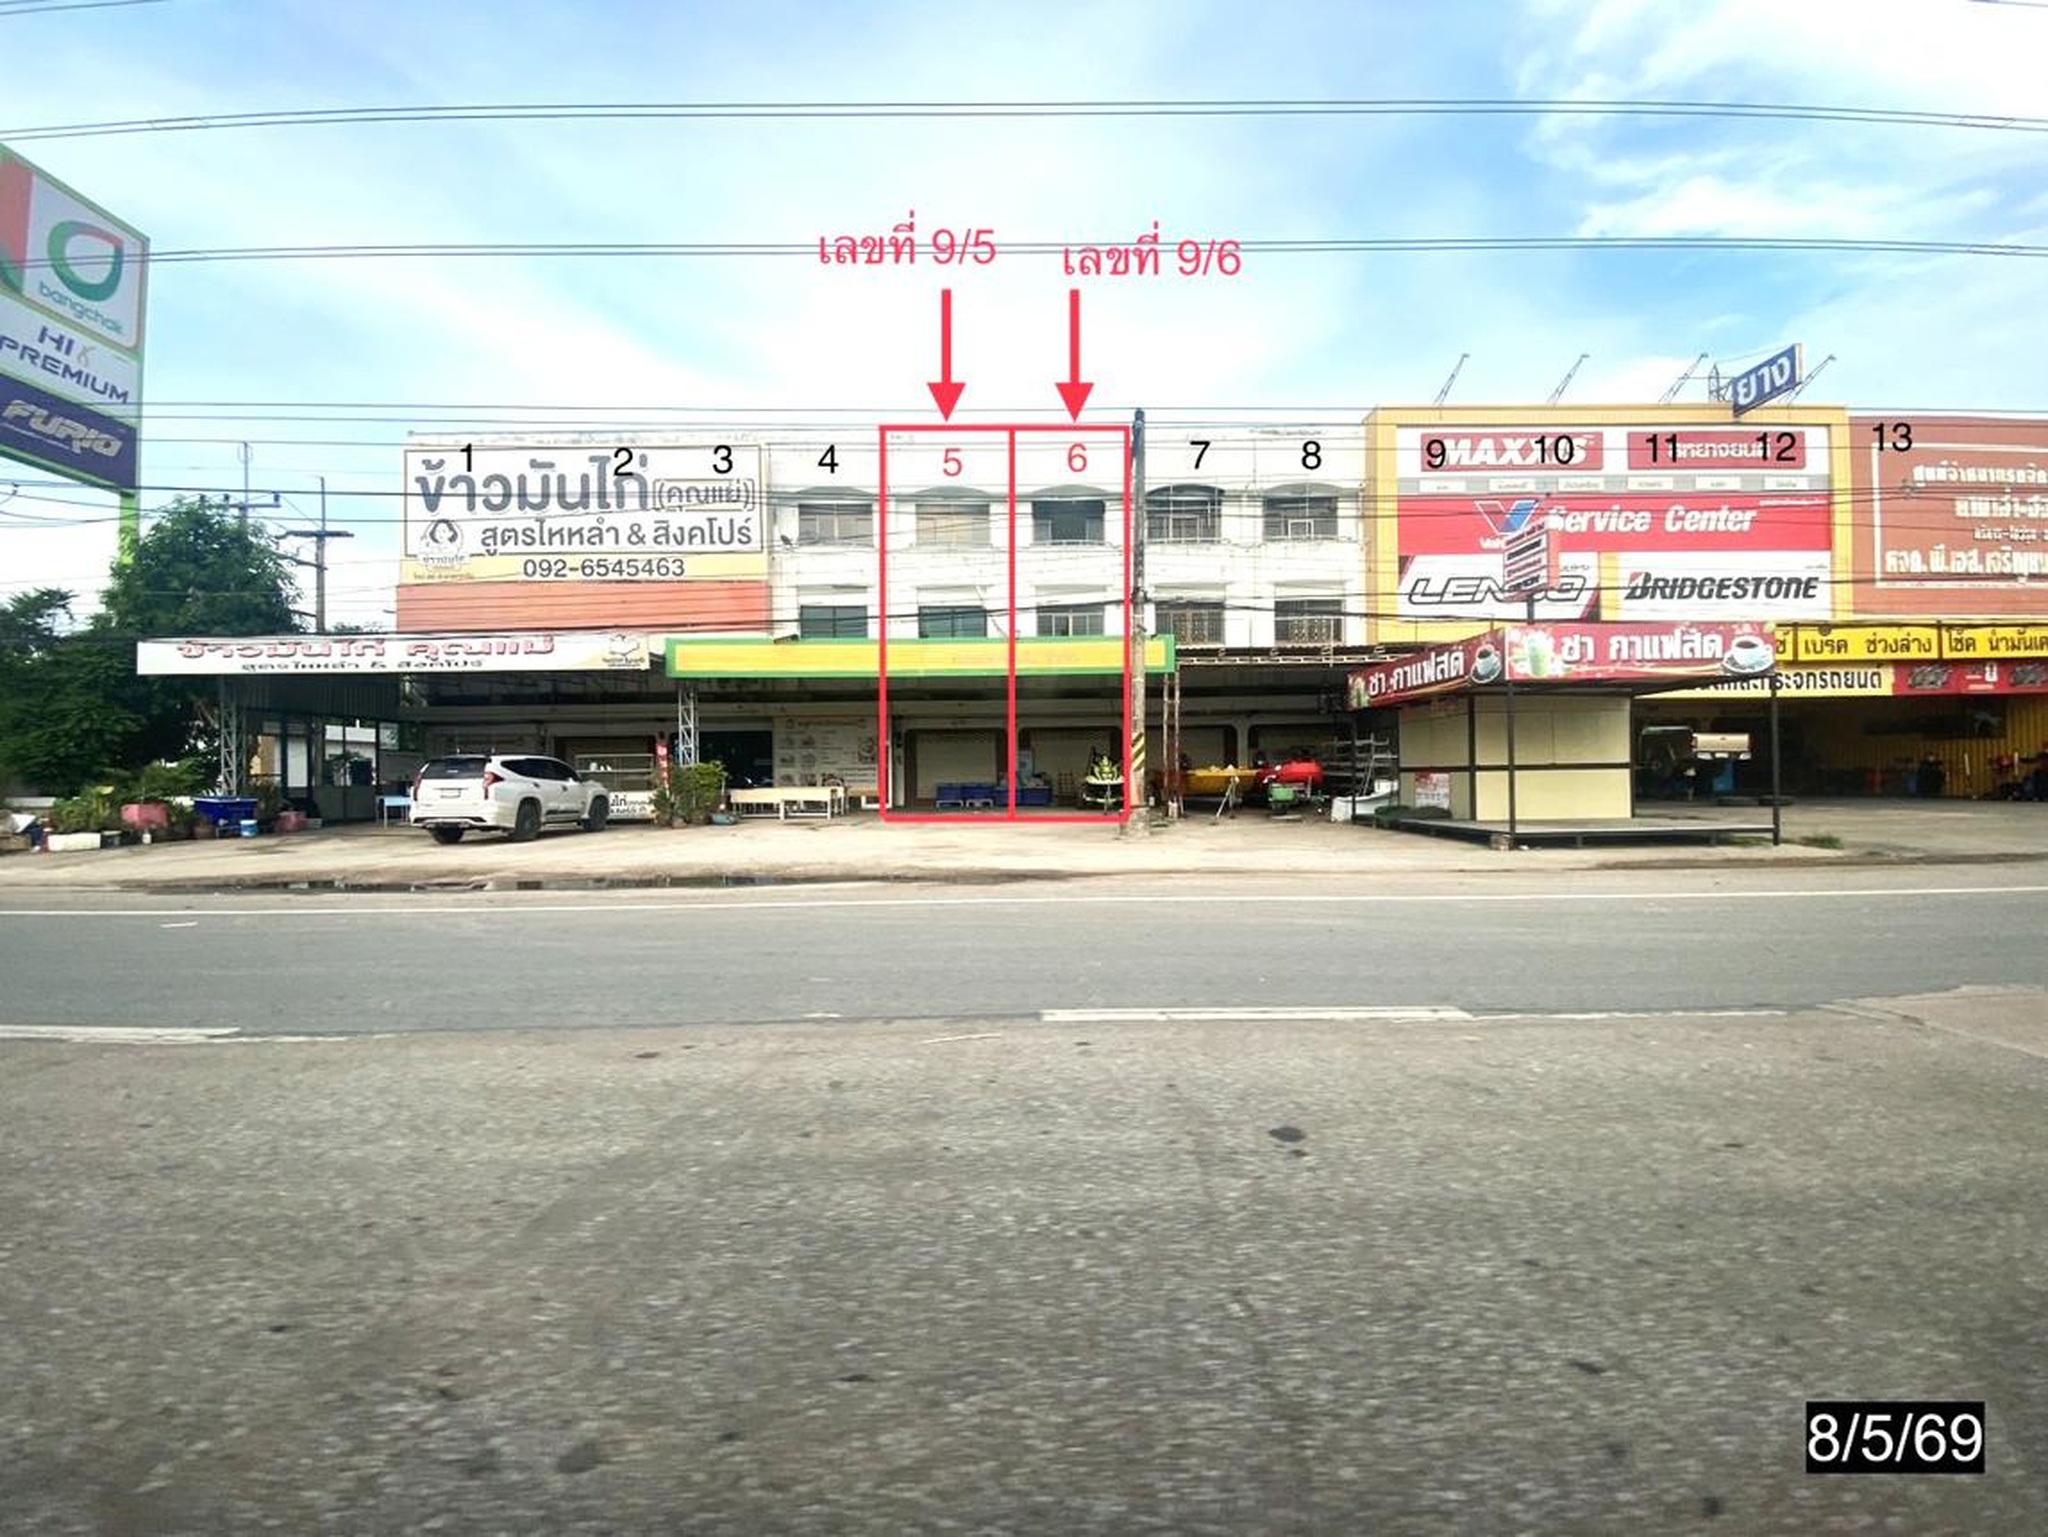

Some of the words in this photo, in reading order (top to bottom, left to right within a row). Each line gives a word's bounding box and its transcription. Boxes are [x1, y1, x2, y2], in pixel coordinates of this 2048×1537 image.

[38, 280, 122, 334] bangchak
[38, 325, 75, 357] HI
[0, 335, 129, 401] PREMIUM
[1736, 355, 1792, 406] ยาง
[415, 453, 649, 513] ข้าวมันไก่
[627, 523, 646, 546] &
[653, 517, 753, 547] สิงคโปร์
[1664, 505, 1757, 532] Center
[523, 557, 686, 579] 092-6545463
[1408, 575, 1587, 605] LENO
[1624, 572, 1820, 600] BRIDGESTONE
[1561, 633, 1595, 662] ชา
